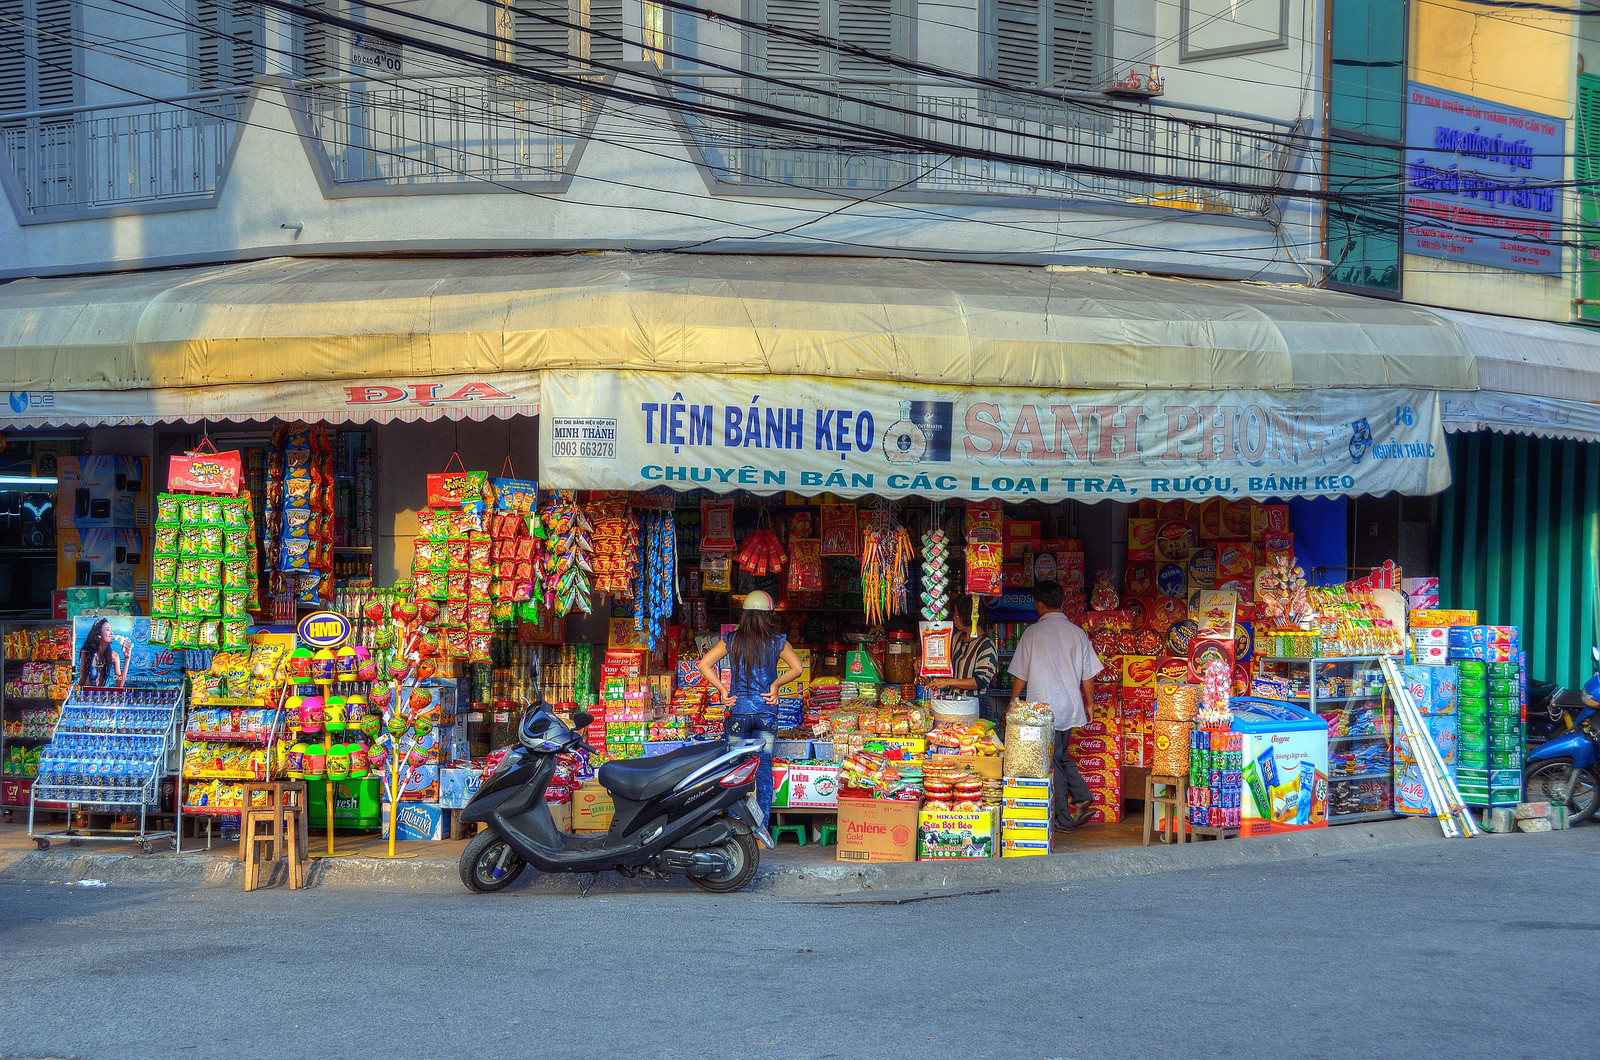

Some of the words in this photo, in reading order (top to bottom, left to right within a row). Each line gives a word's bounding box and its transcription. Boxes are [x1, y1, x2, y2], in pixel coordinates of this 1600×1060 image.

[342, 382, 516, 407] ĐỊA
[1394, 405, 1413, 427] 16
[554, 428, 579, 439] MINH
[582, 425, 615, 440] THÀNH
[641, 392, 714, 454] TIỆM
[724, 394, 804, 450] BÁNH
[815, 408, 875, 461] KẸO
[962, 401, 1146, 464] SANH
[1161, 402, 1328, 465] PHONG
[554, 441, 577, 456] 0903
[580, 442, 614, 457] 663278
[1372, 437, 1404, 460] NGUYỄN
[1404, 439, 1426, 459] THÁI
[640, 465, 786, 485] CHUYÊN
[800, 468, 874, 489] BÁN
[887, 471, 958, 491] CÁC
[971, 476, 1049, 496] LOẠI
[1061, 474, 1138, 496] TRÀ,
[1151, 475, 1239, 494] RƯỢU,
[1248, 473, 1307, 492] BÁNH
[1314, 474, 1355, 493] KẸO
[1162, 527, 1187, 537] Delicious
[309, 621, 342, 638] HMD
[1079, 739, 1102, 749] Coca-Cola
[1079, 756, 1101, 767] Coca-Cola
[791, 772, 809, 783] LIÊN
[337, 797, 358, 809] resh
[396, 806, 432, 836] AQUAFINA
[846, 819, 887, 834] Anlene
[922, 820, 940, 831] Sữa
[846, 833, 864, 841] Gold
